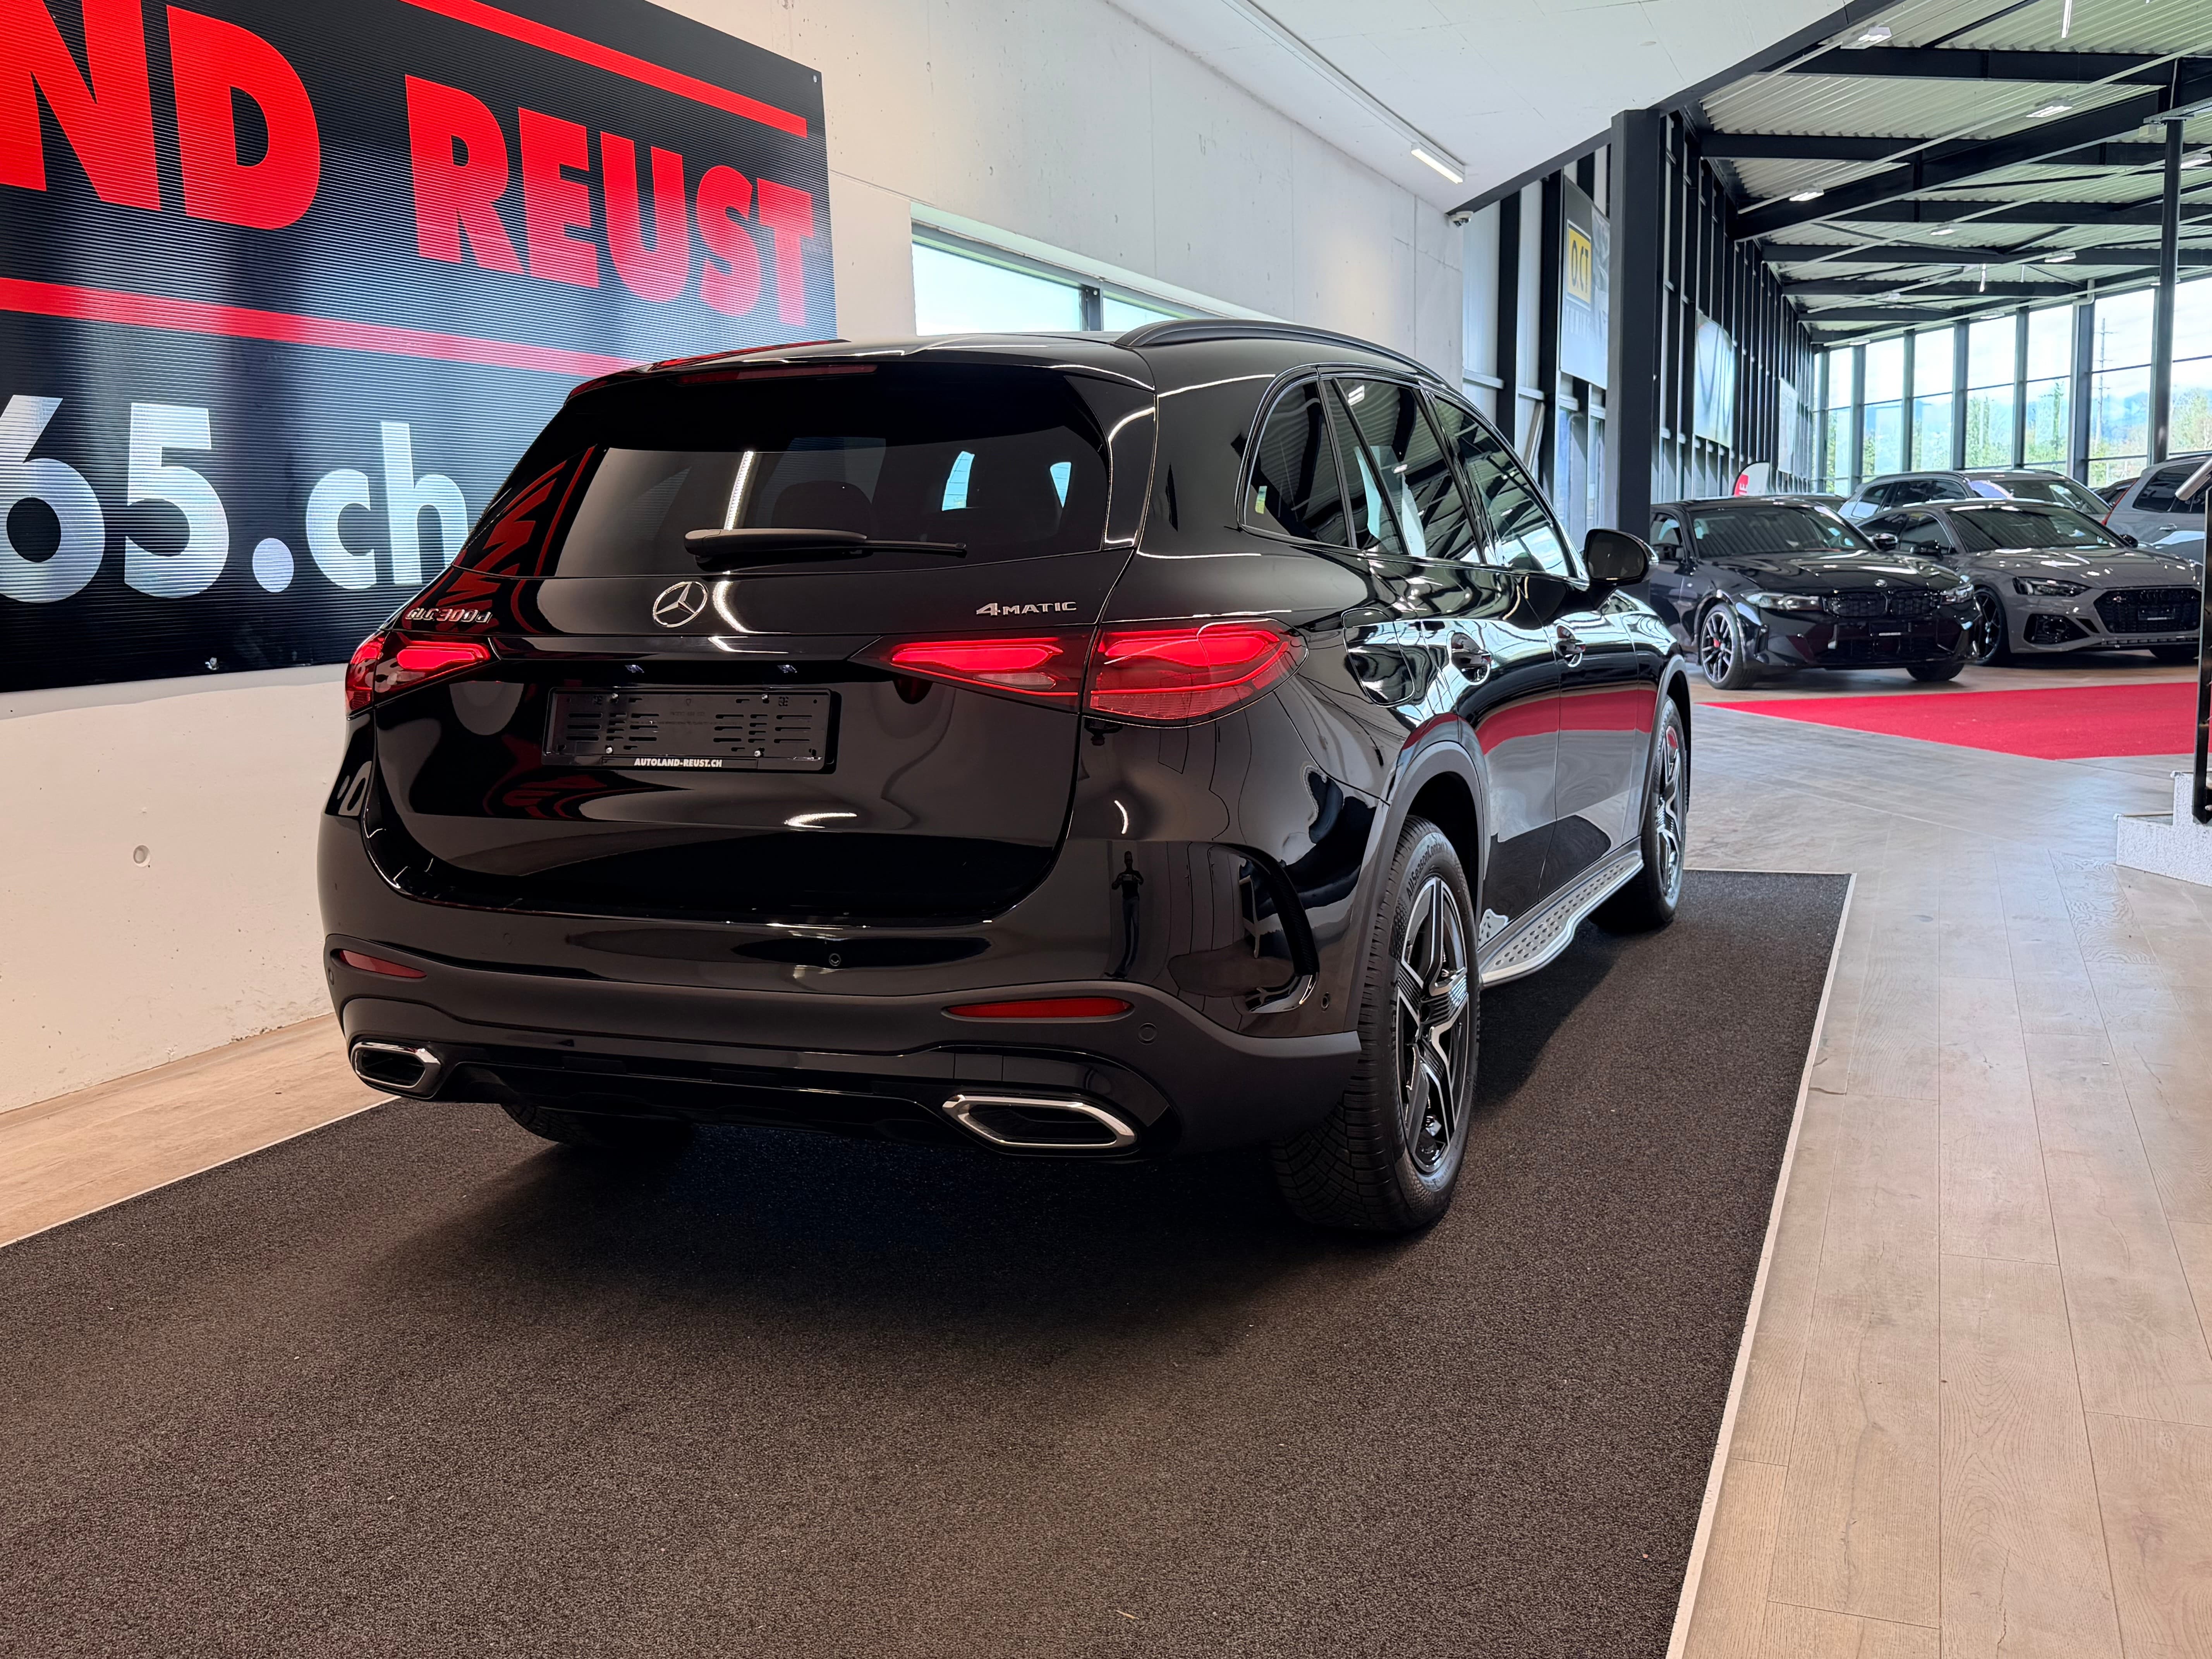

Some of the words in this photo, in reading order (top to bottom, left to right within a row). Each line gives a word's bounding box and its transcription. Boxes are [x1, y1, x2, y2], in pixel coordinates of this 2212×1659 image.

[0, 0, 321, 230] ND
[405, 74, 814, 327] REUST
[0, 394, 471, 603] 65.ch
[976, 601, 1077, 616] 4MATIC
[634, 758, 723, 768] AUTOLAND-REUST.CH
